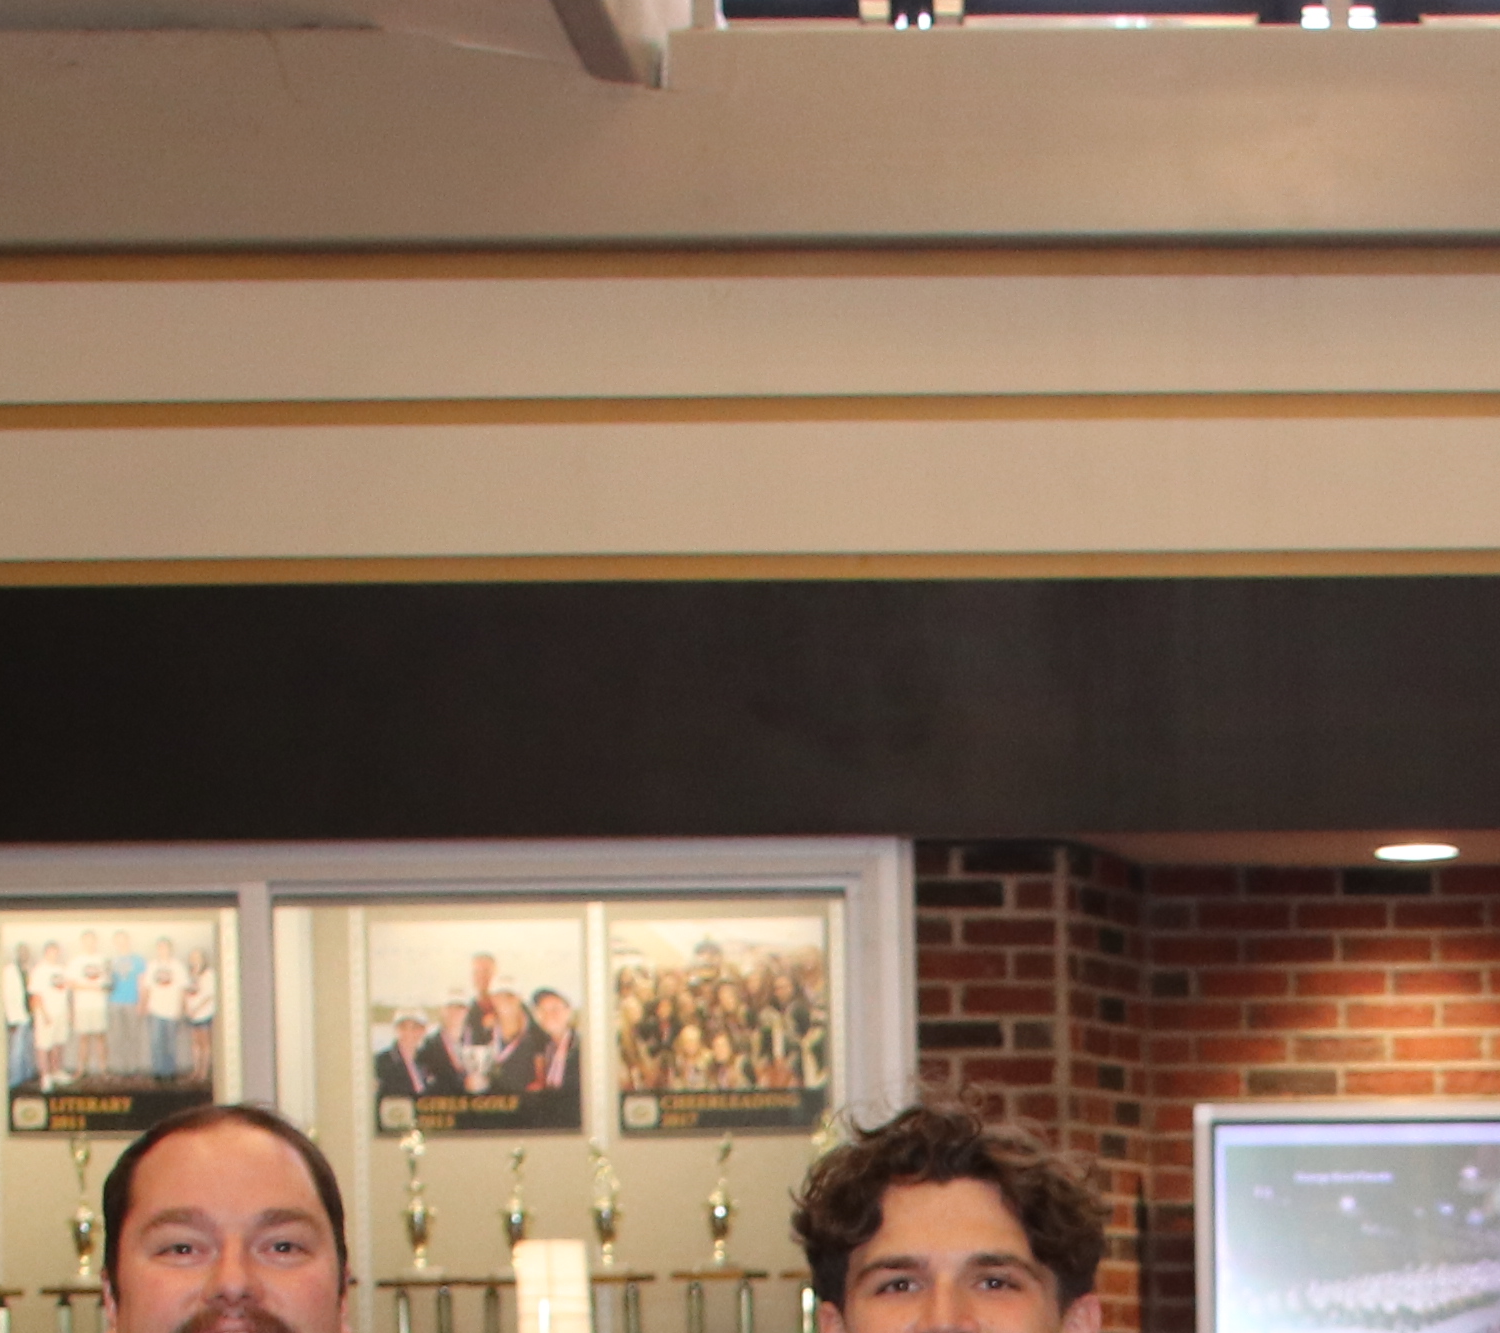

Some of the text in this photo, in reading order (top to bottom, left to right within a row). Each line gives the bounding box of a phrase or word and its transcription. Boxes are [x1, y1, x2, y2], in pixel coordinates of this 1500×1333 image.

[50, 1096, 132, 1113] LITERARY
[417, 1095, 520, 1111] GIRLS GOLF
